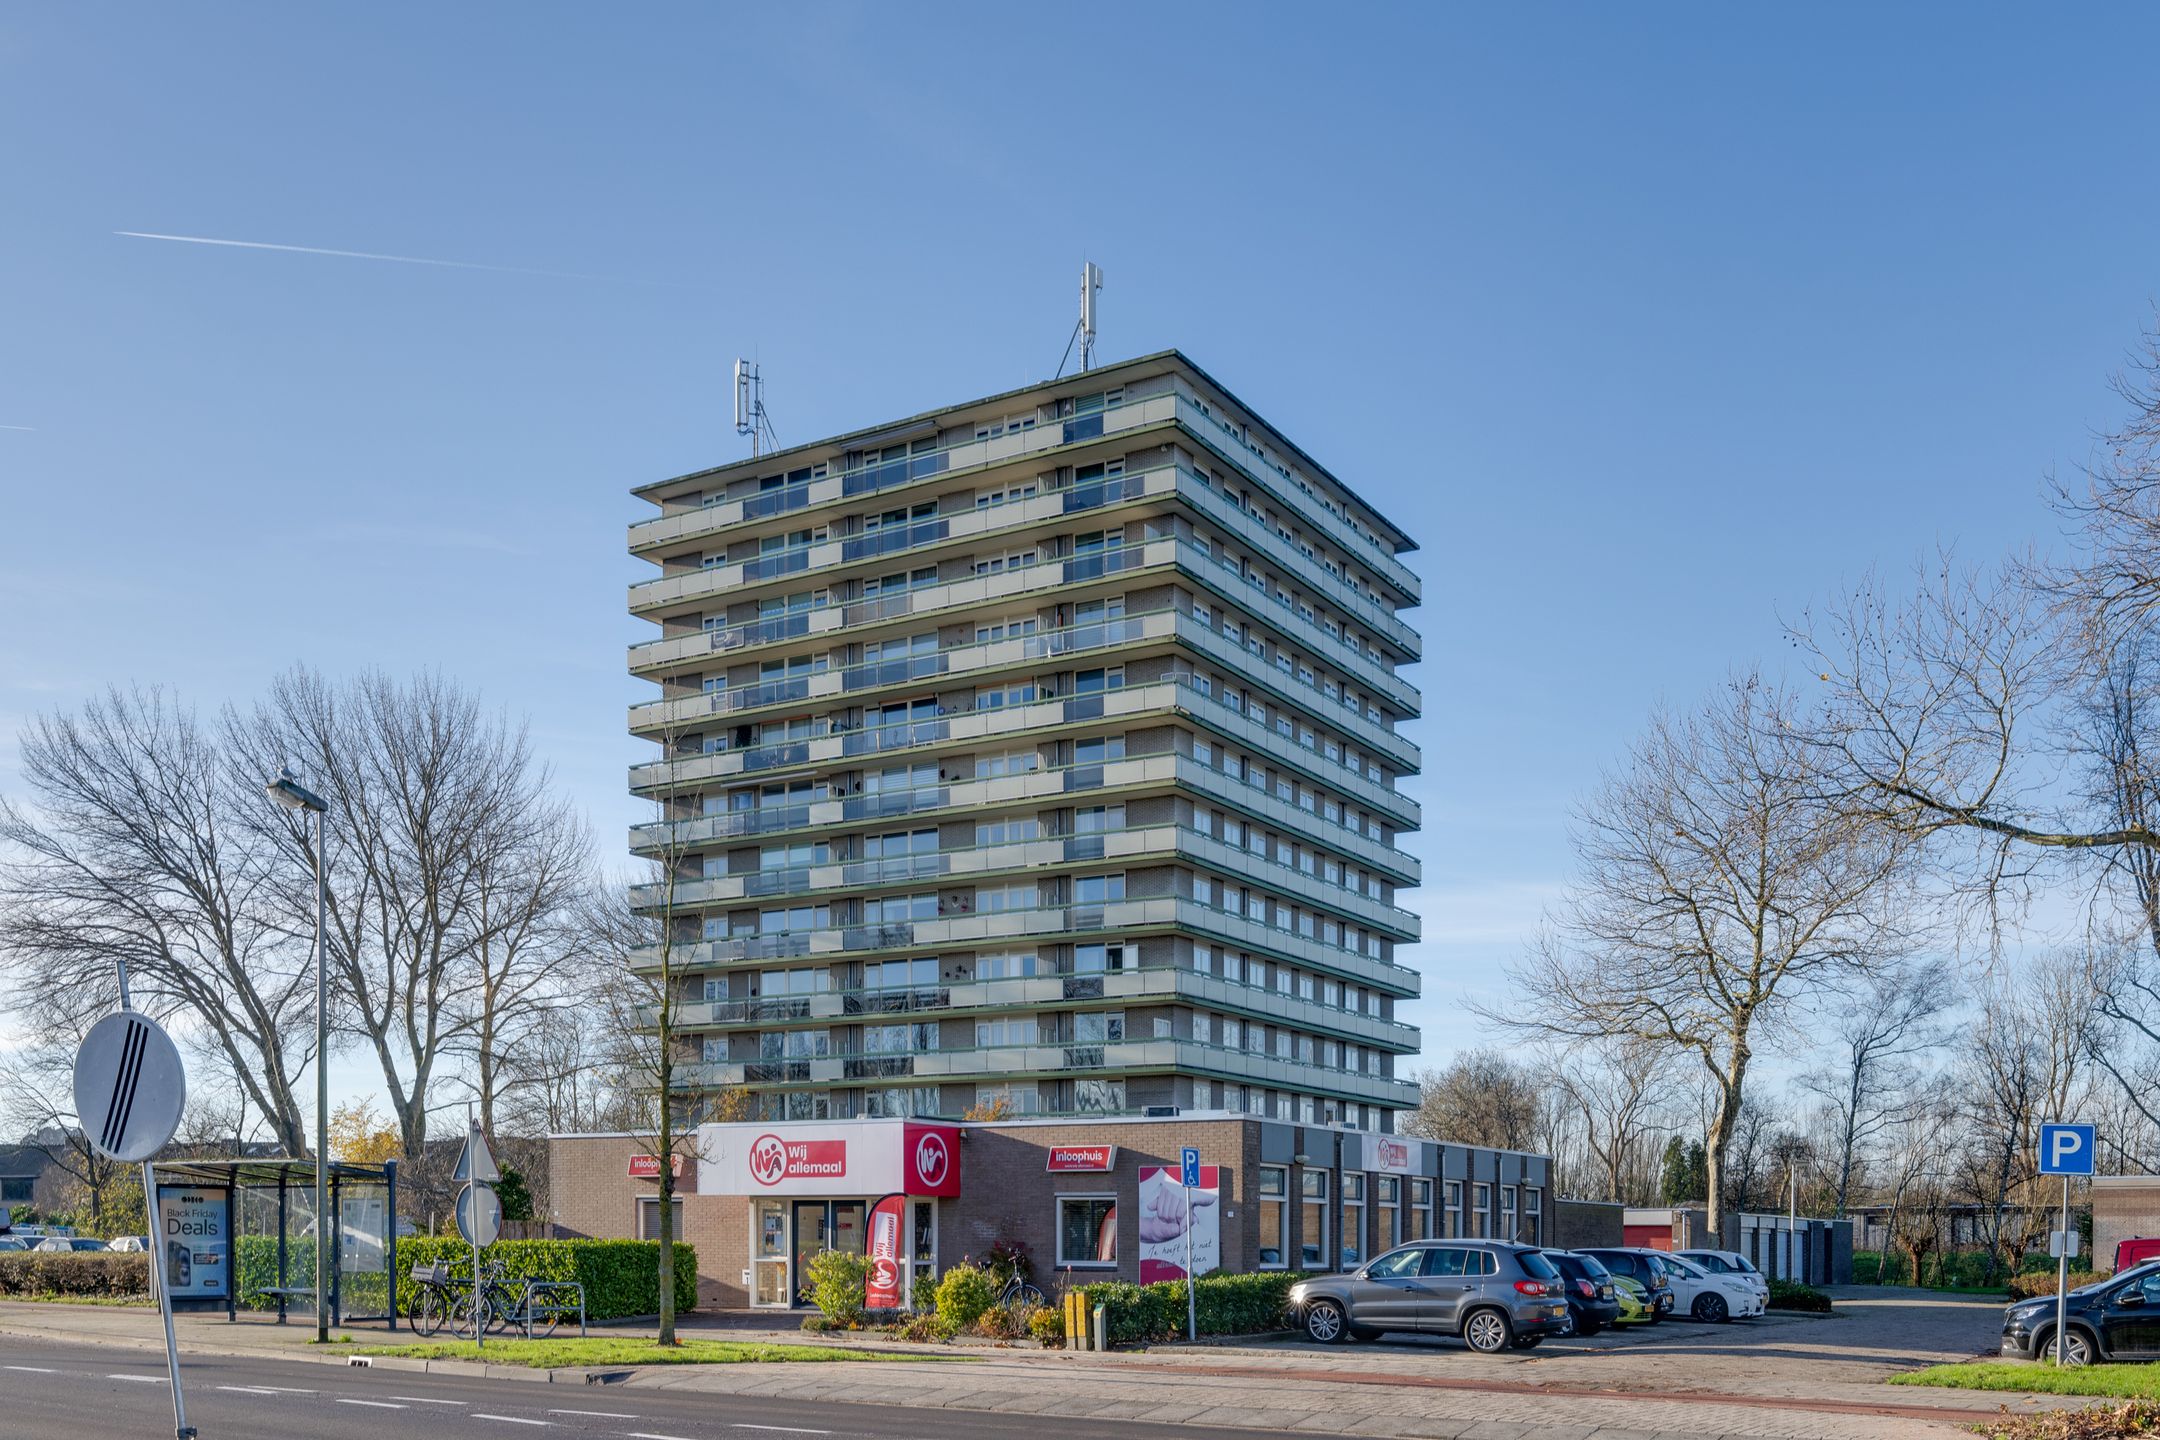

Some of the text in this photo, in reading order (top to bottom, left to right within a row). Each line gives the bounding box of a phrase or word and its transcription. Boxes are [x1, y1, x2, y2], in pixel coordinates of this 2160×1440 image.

[788, 1145, 807, 1161] Wij
[1055, 1150, 1103, 1163] inloophuis
[2052, 1130, 2082, 1168] P
[788, 1161, 842, 1174] allemaal
[1186, 1151, 1196, 1171] P
[167, 1208, 218, 1219] Black Friday
[167, 1219, 218, 1235] Deals
[875, 1242, 886, 1257] Wij
